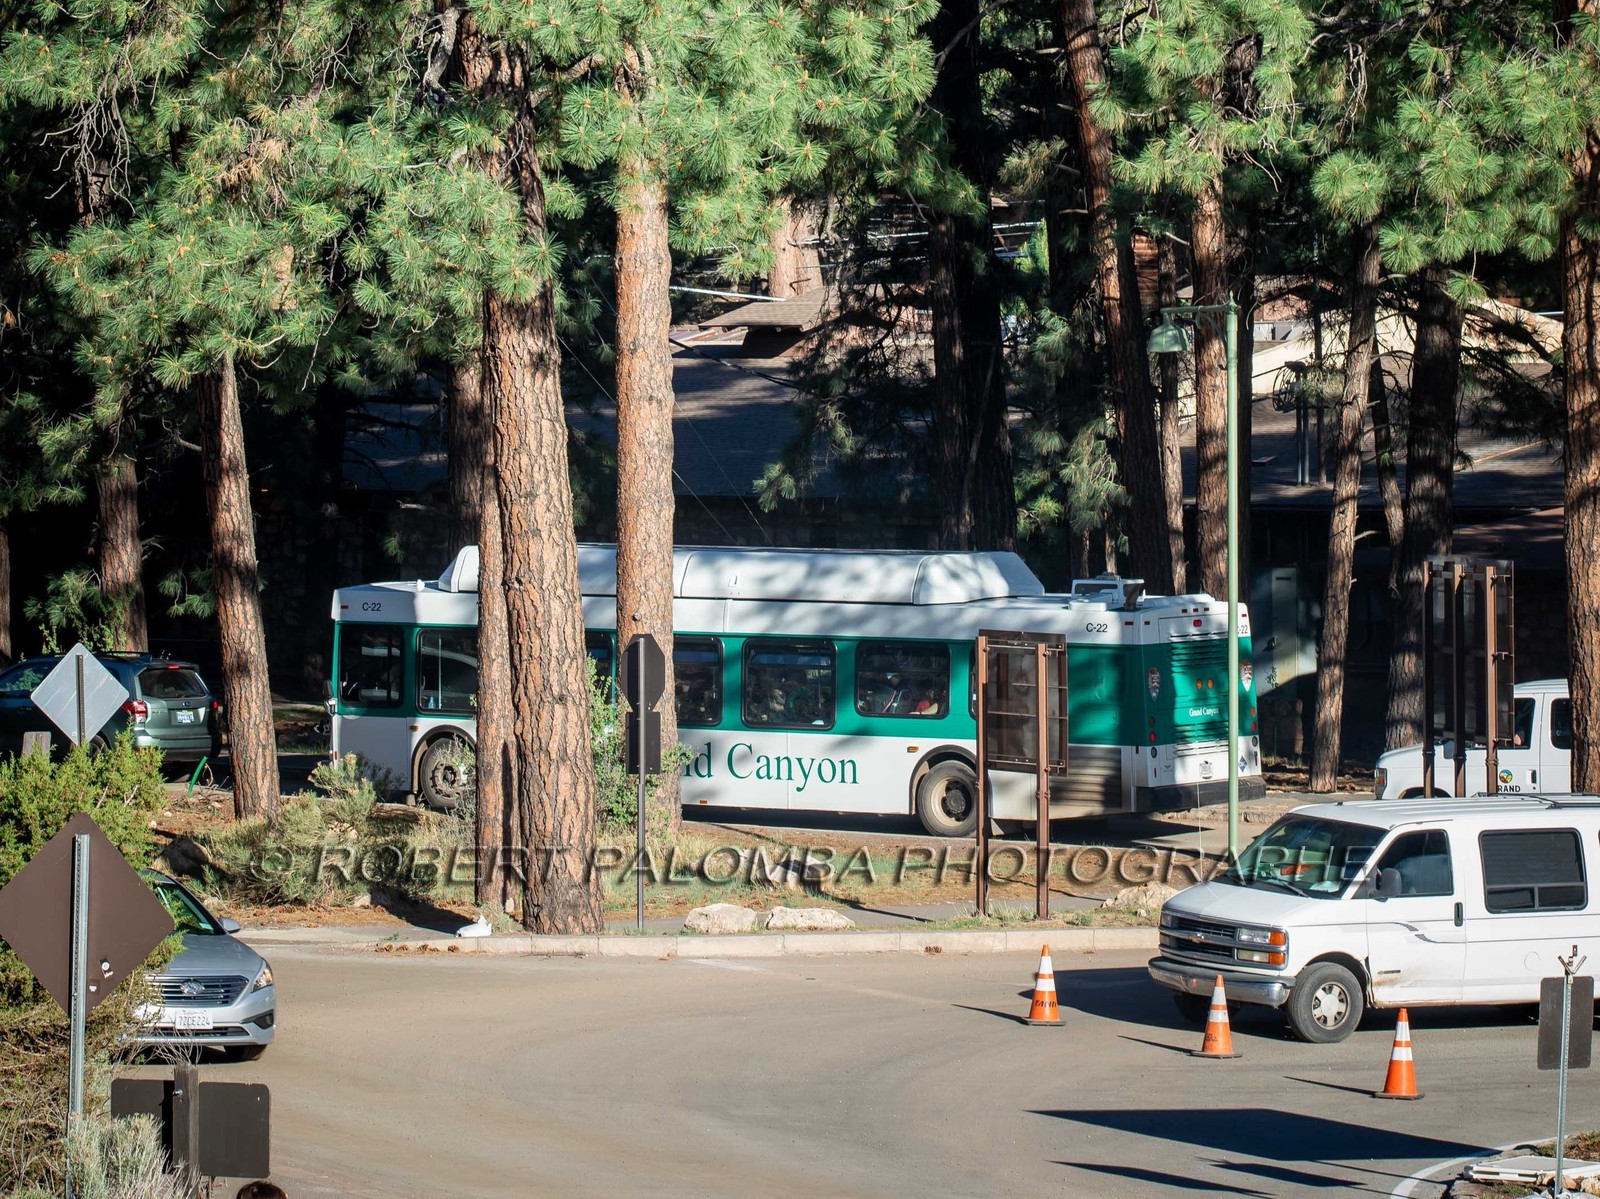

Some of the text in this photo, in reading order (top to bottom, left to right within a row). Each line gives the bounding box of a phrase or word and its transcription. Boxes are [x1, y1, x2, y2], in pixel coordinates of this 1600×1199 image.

[362, 602, 382, 612] C-22
[1086, 623, 1108, 633] C-22
[727, 743, 860, 793] Canyon
